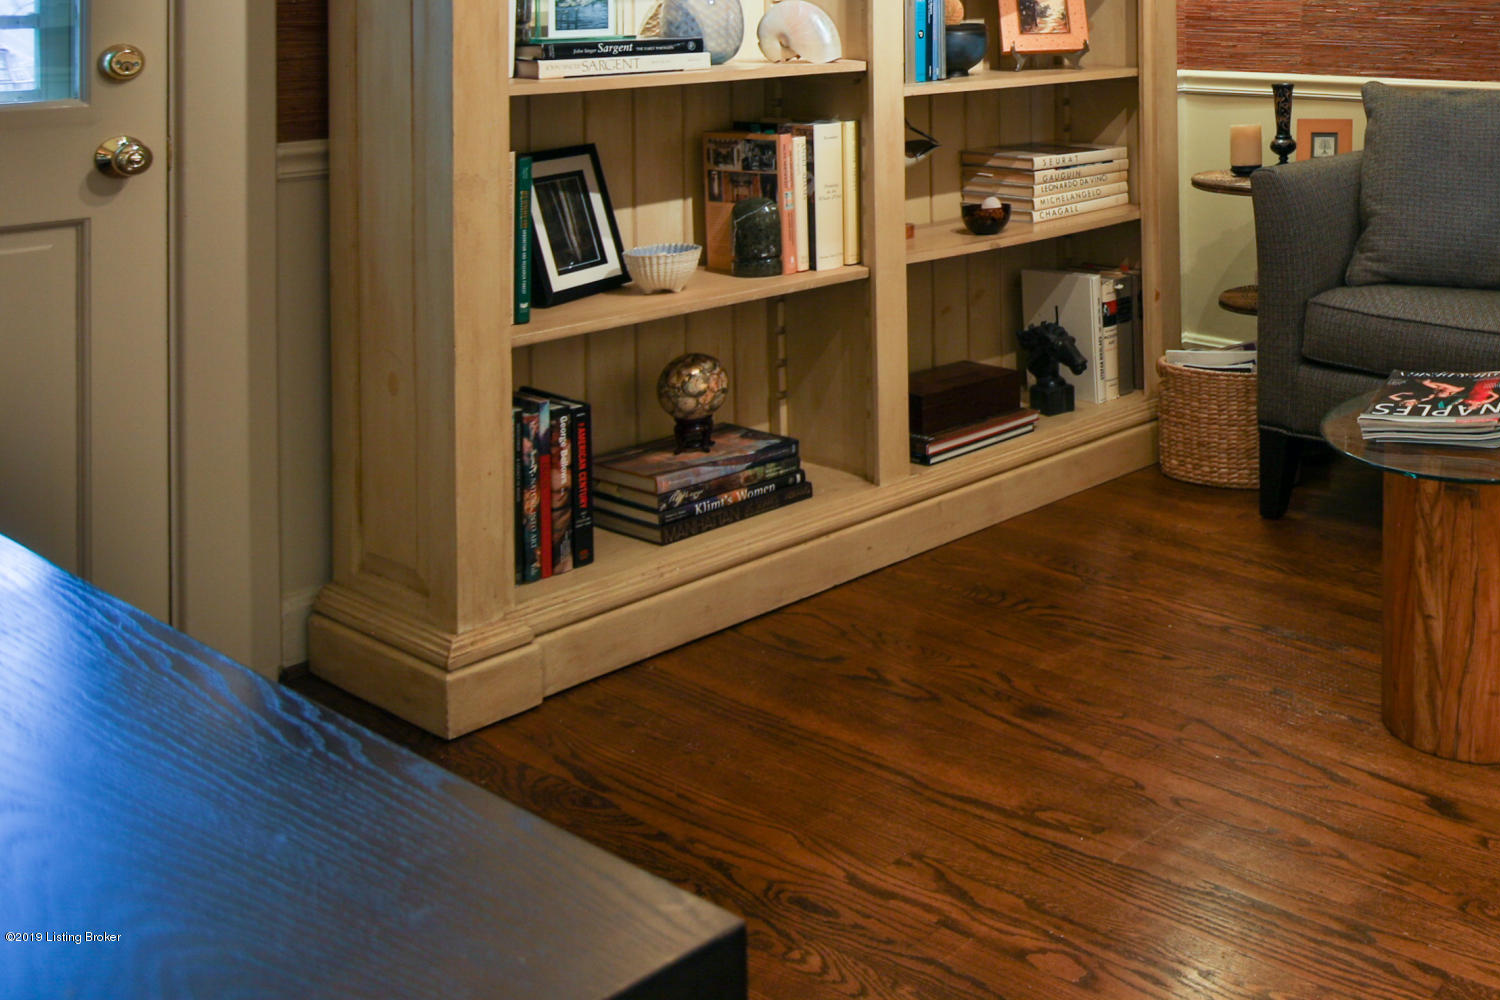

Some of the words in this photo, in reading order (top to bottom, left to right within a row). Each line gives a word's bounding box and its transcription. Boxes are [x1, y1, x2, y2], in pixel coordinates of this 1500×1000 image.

[597, 42, 633, 55] Sargent
[581, 57, 640, 72] SARGENT
[1042, 154, 1079, 166] SEURAT
[1042, 170, 1081, 183] GAUGUIN
[1040, 179, 1078, 193] LEONARDO
[1040, 188, 1102, 206] MICHELANGELO
[558, 415, 569, 447] George
[577, 428, 587, 470] AMERICAN
[560, 449, 569, 485] Bellows
[577, 471, 588, 509] CENTURY
[694, 494, 733, 516] Klimt's
[735, 482, 776, 502] Women
